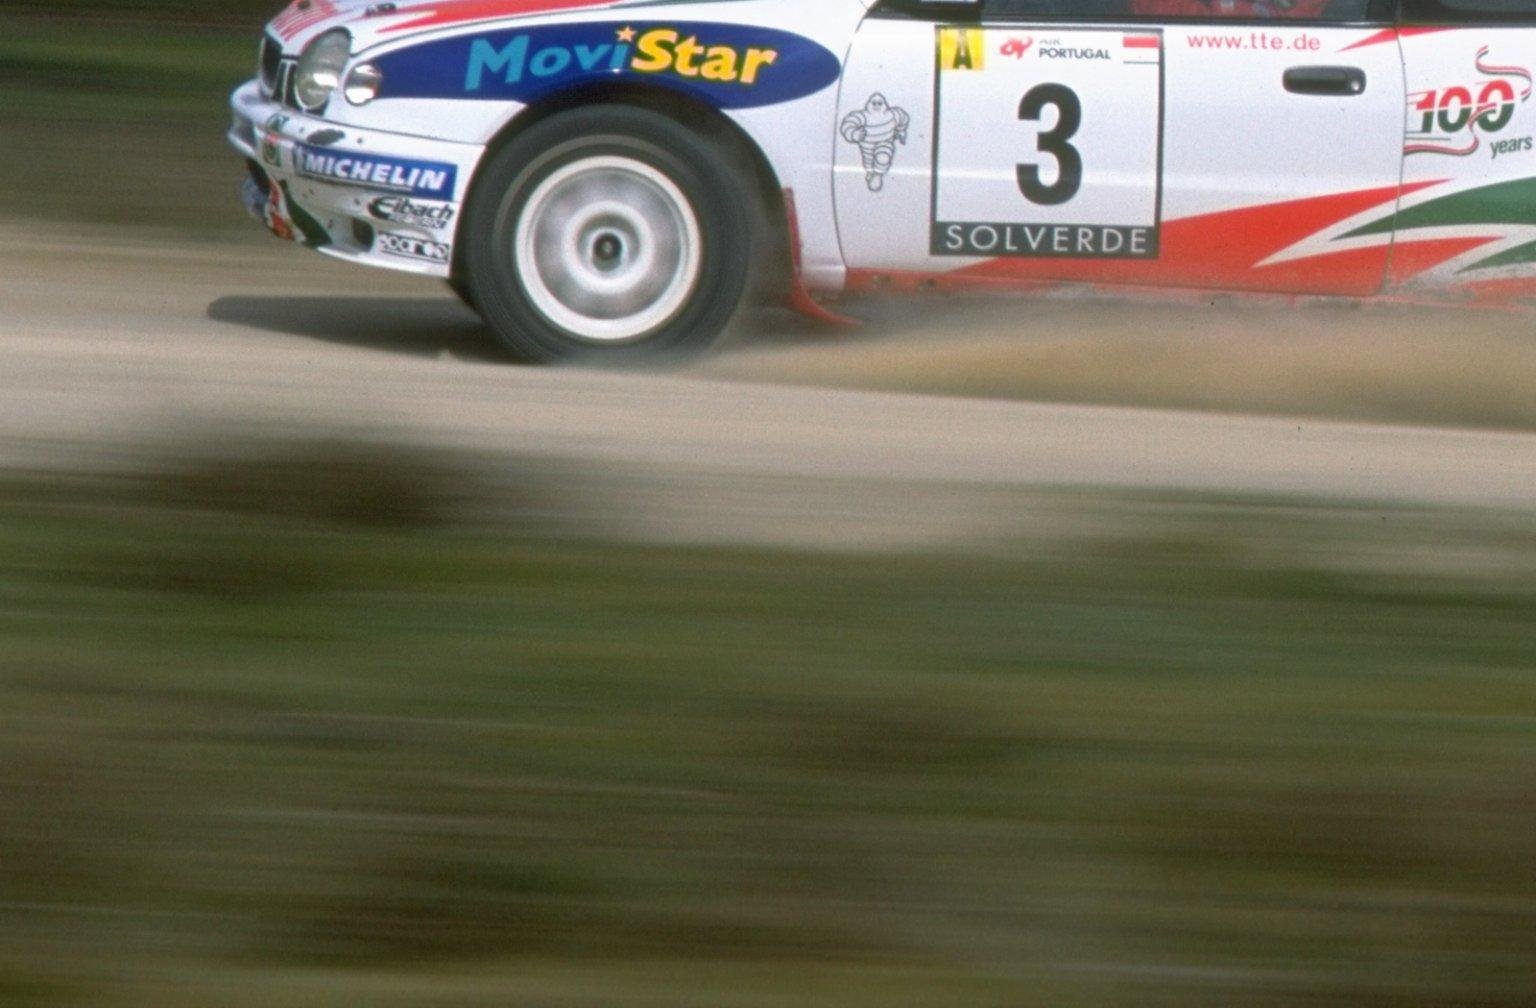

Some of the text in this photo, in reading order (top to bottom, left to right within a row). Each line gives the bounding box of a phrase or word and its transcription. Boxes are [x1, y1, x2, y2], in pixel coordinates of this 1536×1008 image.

[1039, 47, 1111, 60] PORTUGAL
[1187, 32, 1321, 50] www.tte.de
[464, 26, 778, 91] MoviStar
[1416, 78, 1516, 133] 100
[1015, 82, 1083, 206] 3
[1489, 136, 1533, 160] years
[305, 153, 447, 190] MICHELIN
[367, 195, 454, 221] Eibach
[945, 224, 1148, 253] SOLVERDE
